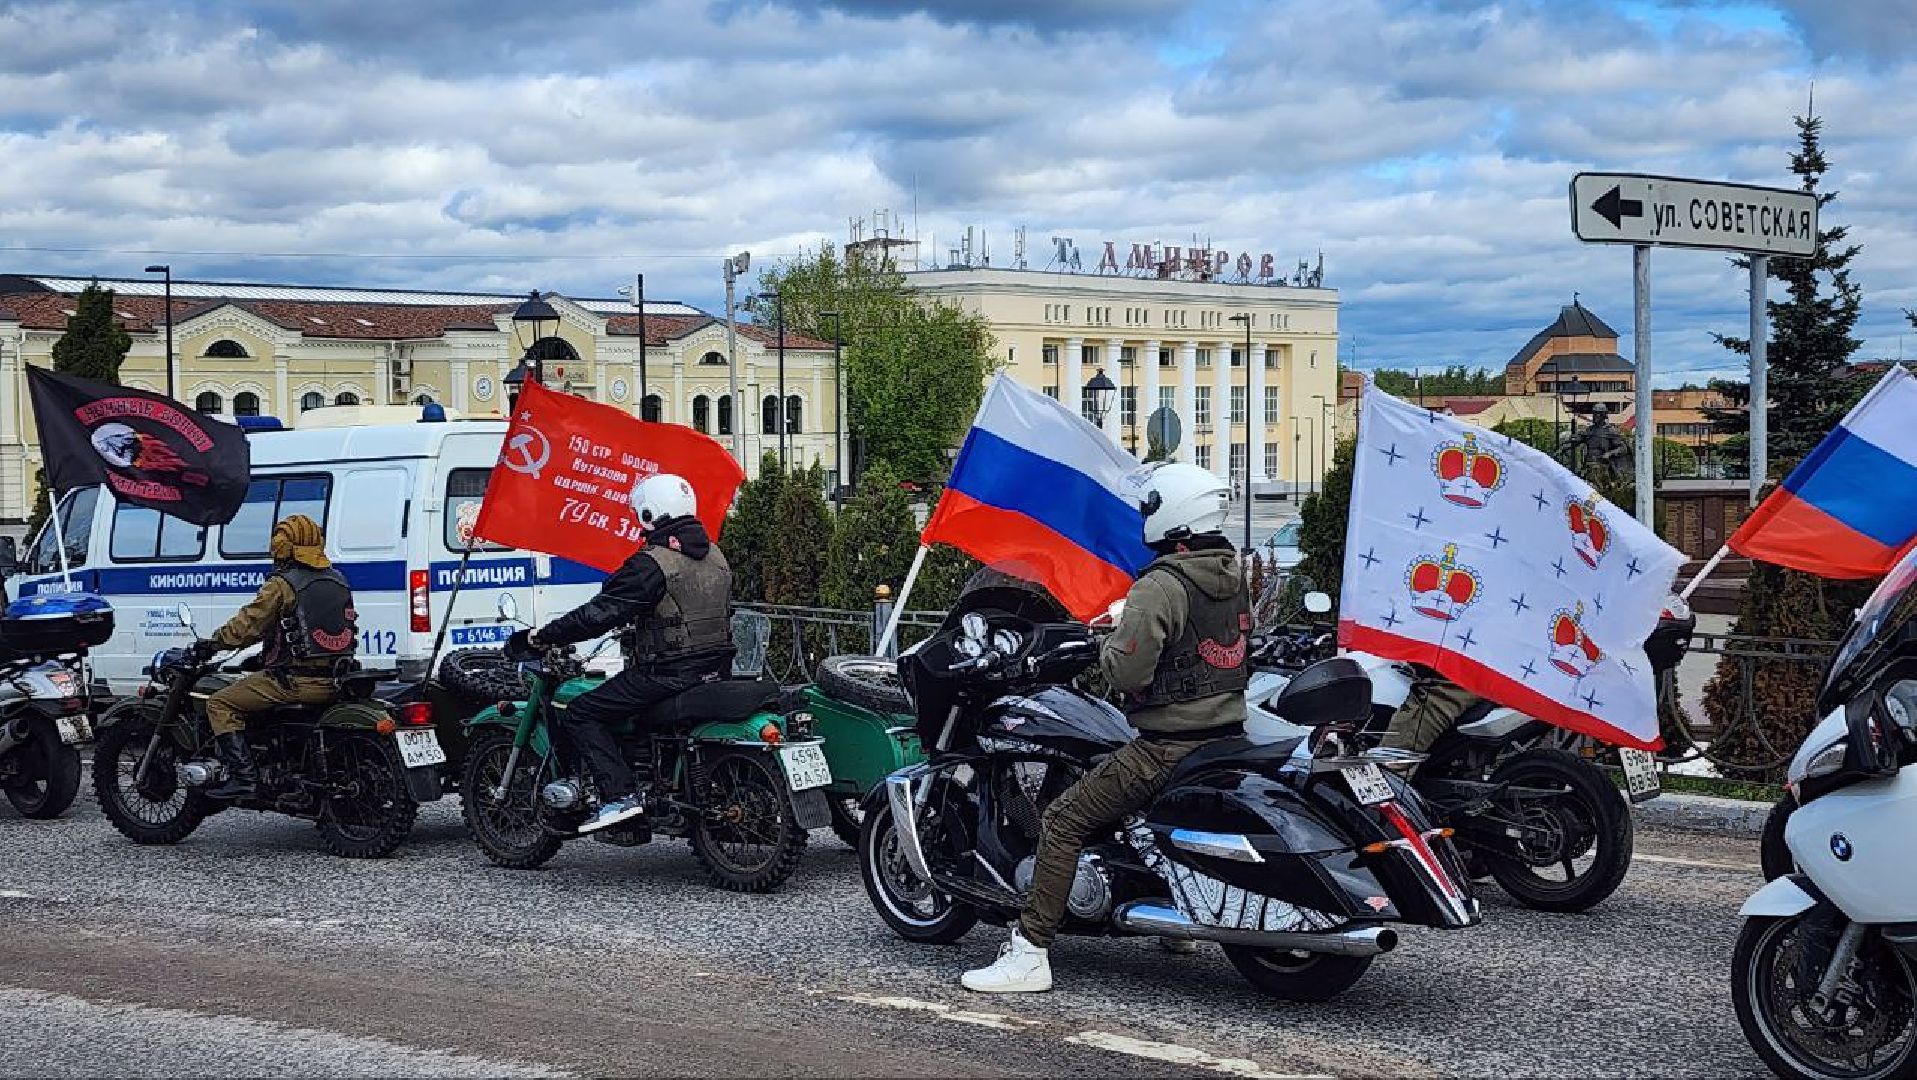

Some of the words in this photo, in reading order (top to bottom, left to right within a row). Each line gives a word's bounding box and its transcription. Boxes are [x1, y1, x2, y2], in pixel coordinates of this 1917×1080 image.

[1653, 202, 1682, 236] ул.
[1689, 198, 1811, 240] СОВЕТСКАЯ
[568, 434, 590, 454] 150
[559, 497, 591, 523] 79
[150, 572, 265, 588] КИНОЛОГИЧЕСКА
[437, 566, 525, 586] ПОЛИЦИЯ
[361, 630, 397, 654] 112
